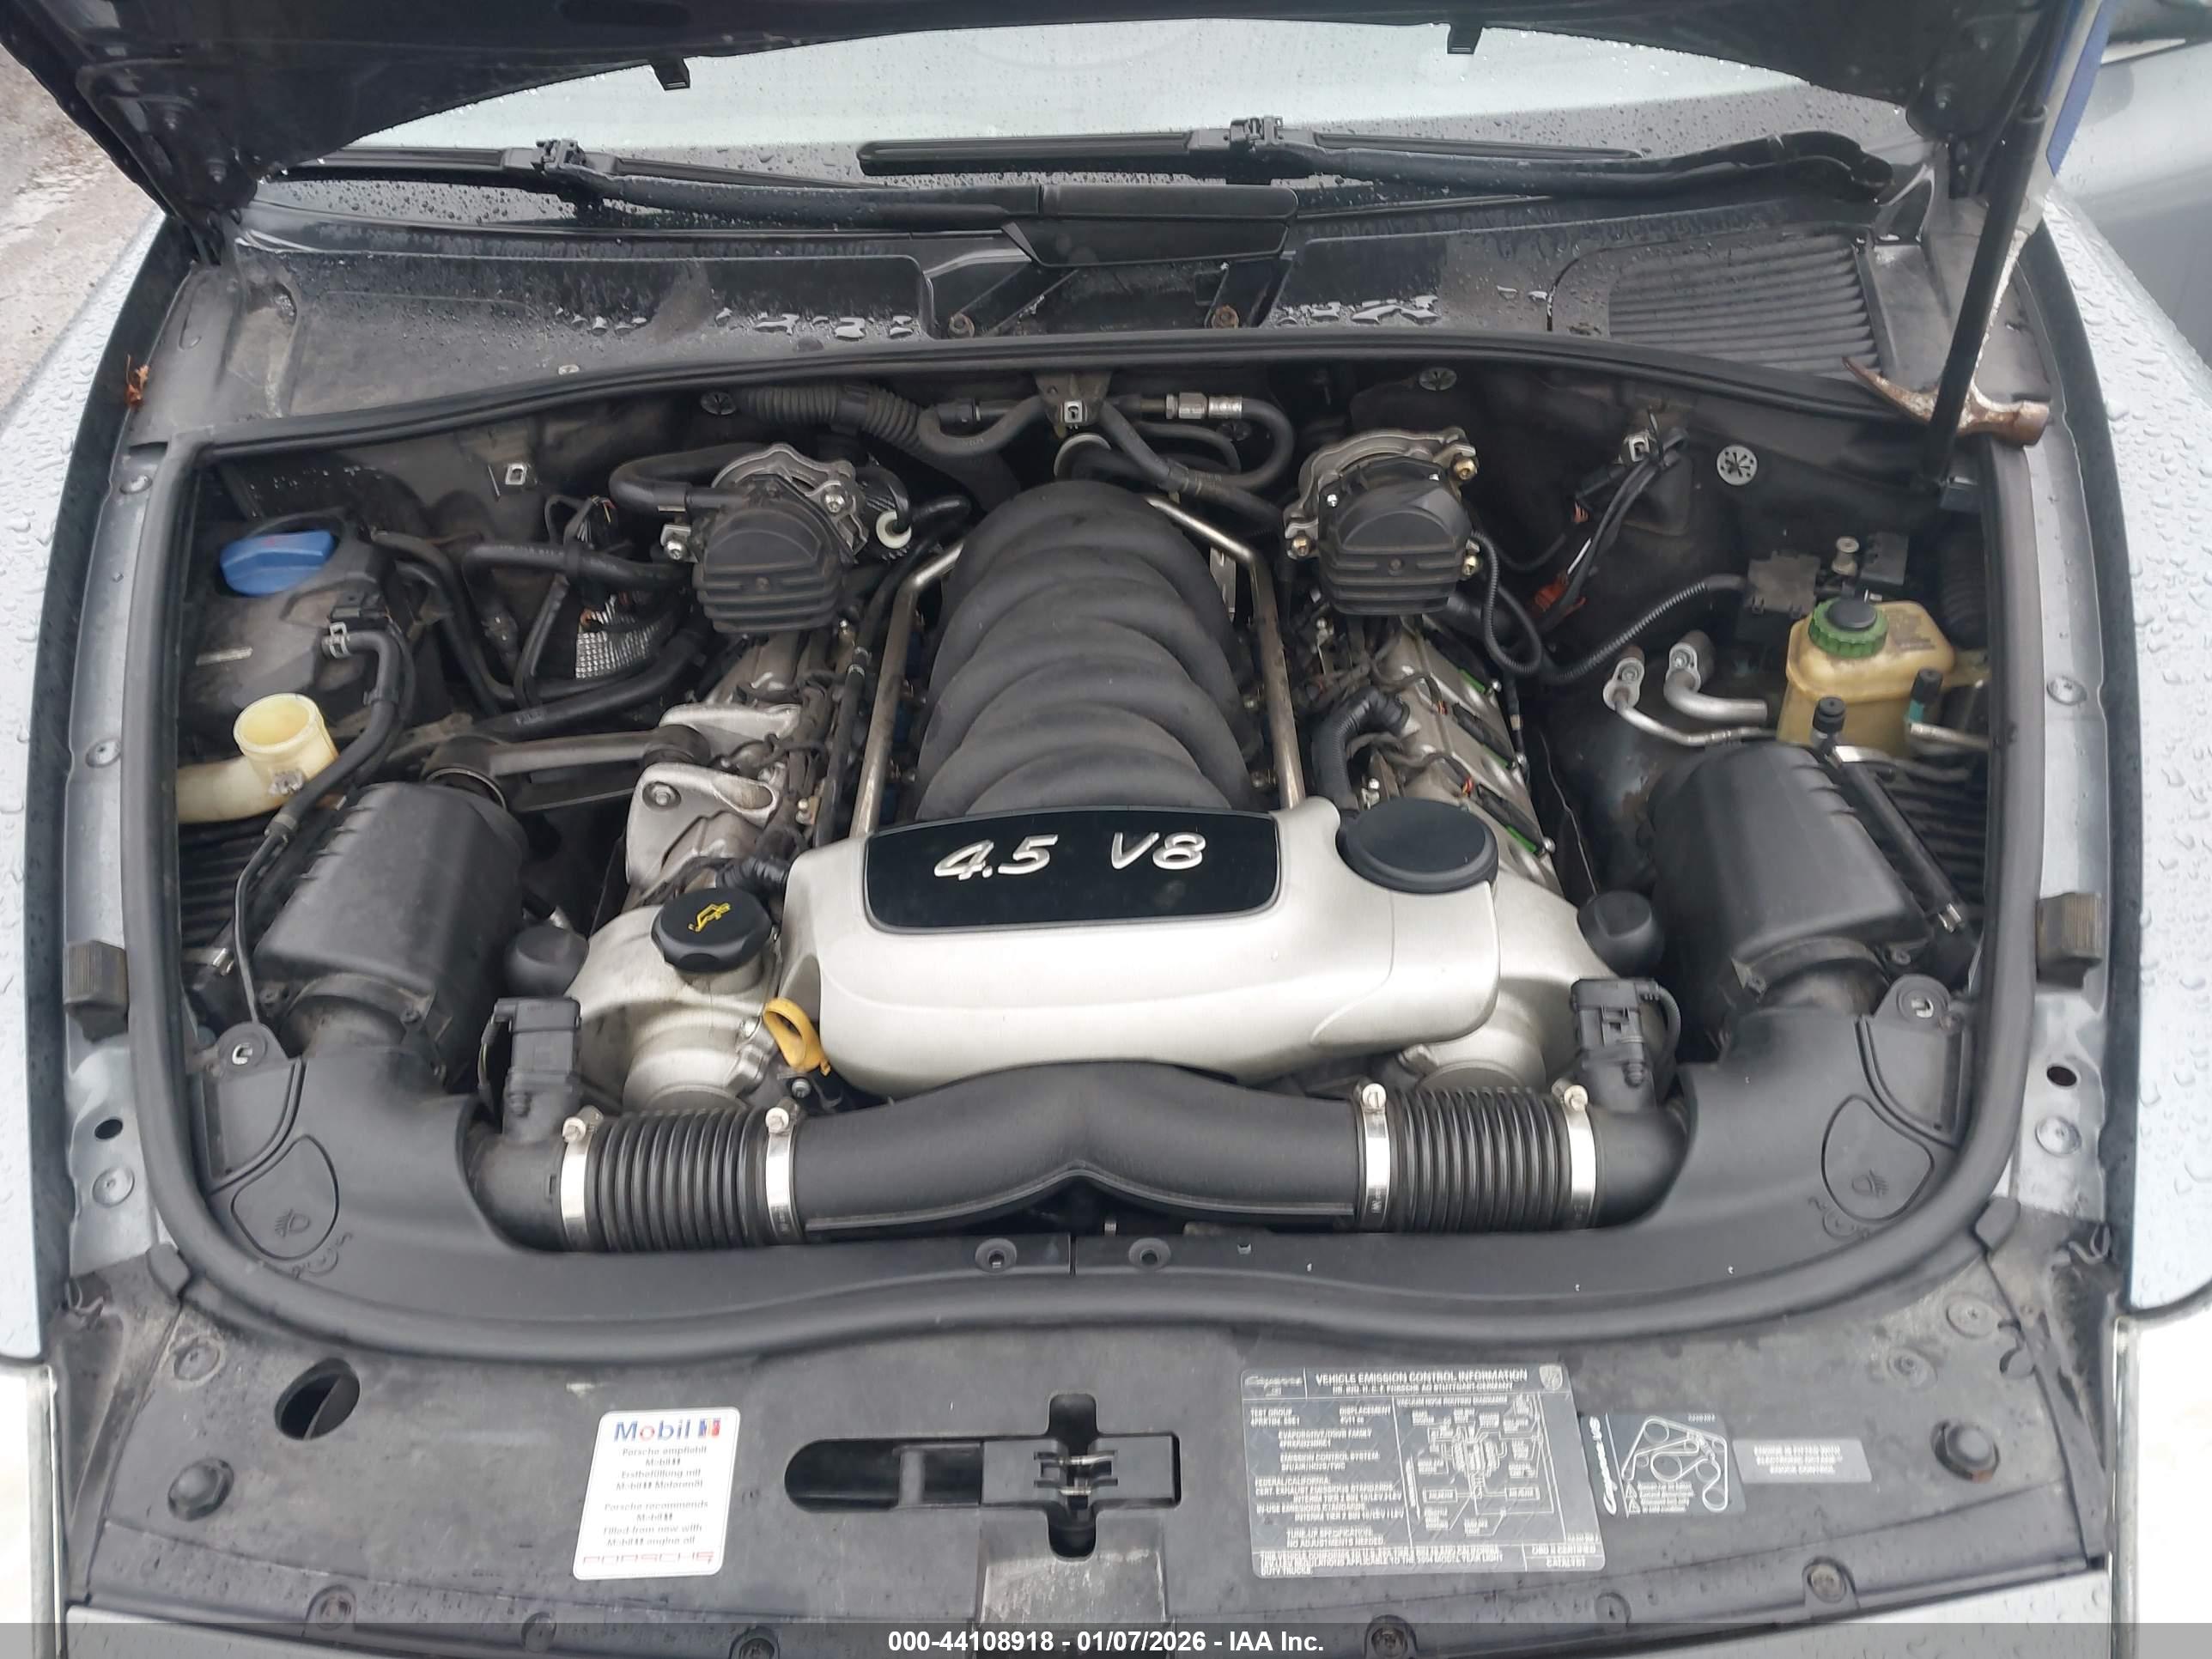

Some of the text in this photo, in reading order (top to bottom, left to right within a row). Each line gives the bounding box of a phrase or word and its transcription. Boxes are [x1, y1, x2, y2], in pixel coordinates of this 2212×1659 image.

[934, 831, 1206, 880] 4.5 V8
[1316, 1373, 1356, 1385] VEHICLE
[1458, 1368, 1528, 1382] INFORMATION
[614, 1419, 690, 1443] Mobil
[583, 1551, 714, 1565] PORSCHE
